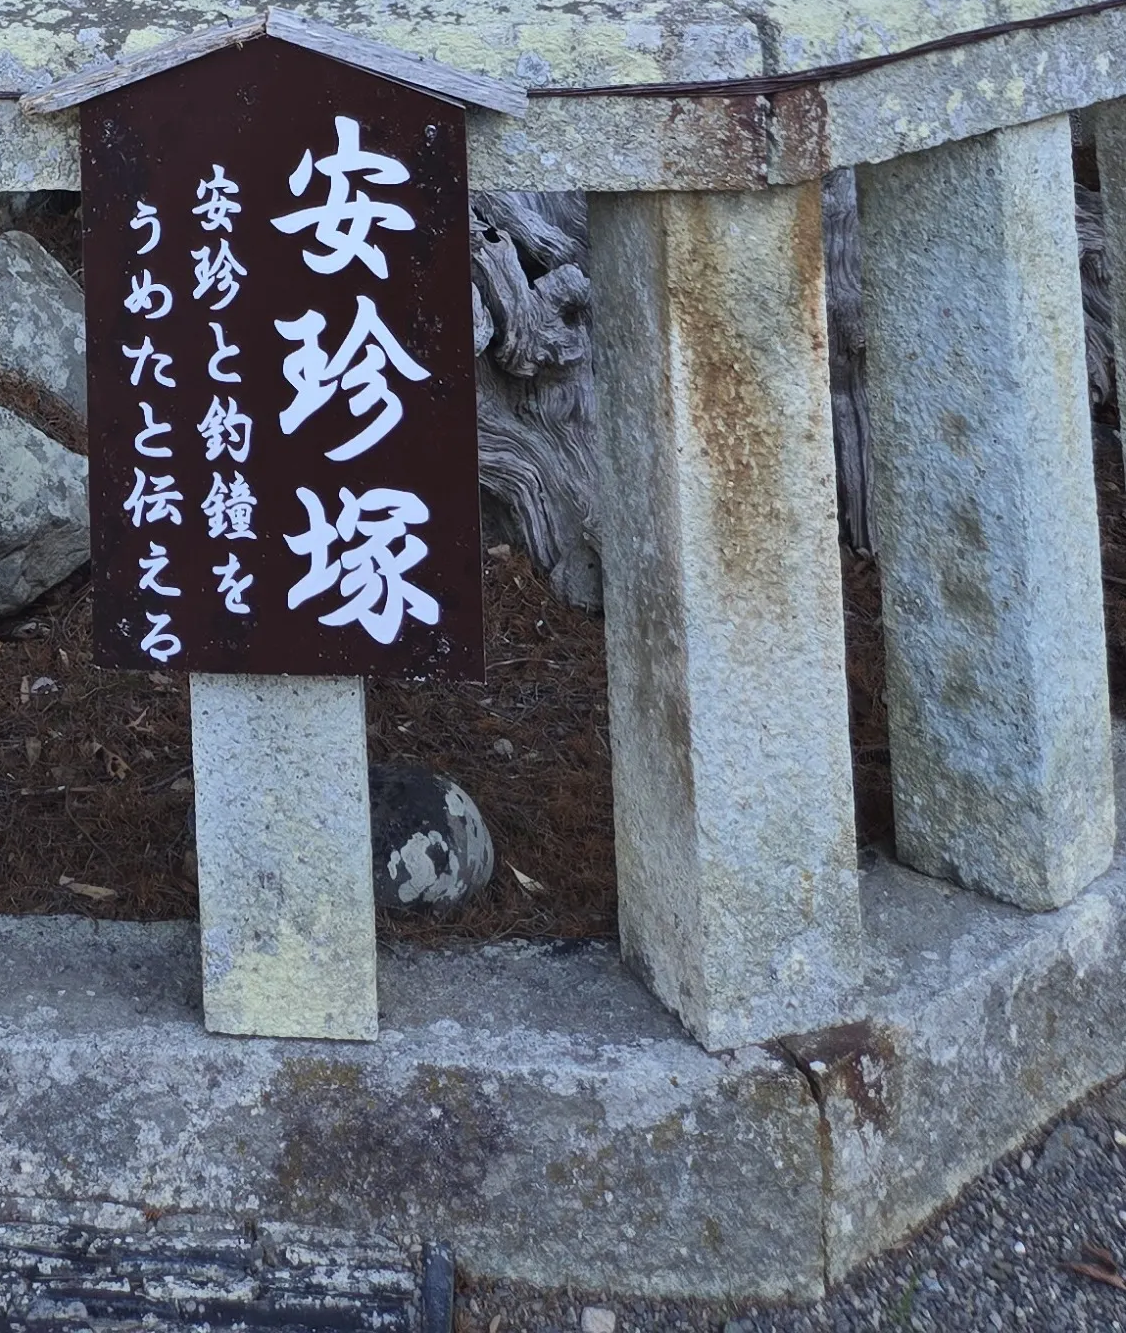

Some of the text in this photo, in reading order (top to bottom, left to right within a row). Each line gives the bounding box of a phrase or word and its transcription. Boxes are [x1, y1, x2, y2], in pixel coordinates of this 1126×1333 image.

[122, 201, 183, 662] うめたと伝える
[191, 164, 257, 613] 安珍と釣鐘を
[270, 116, 439, 644] 安珍塚
